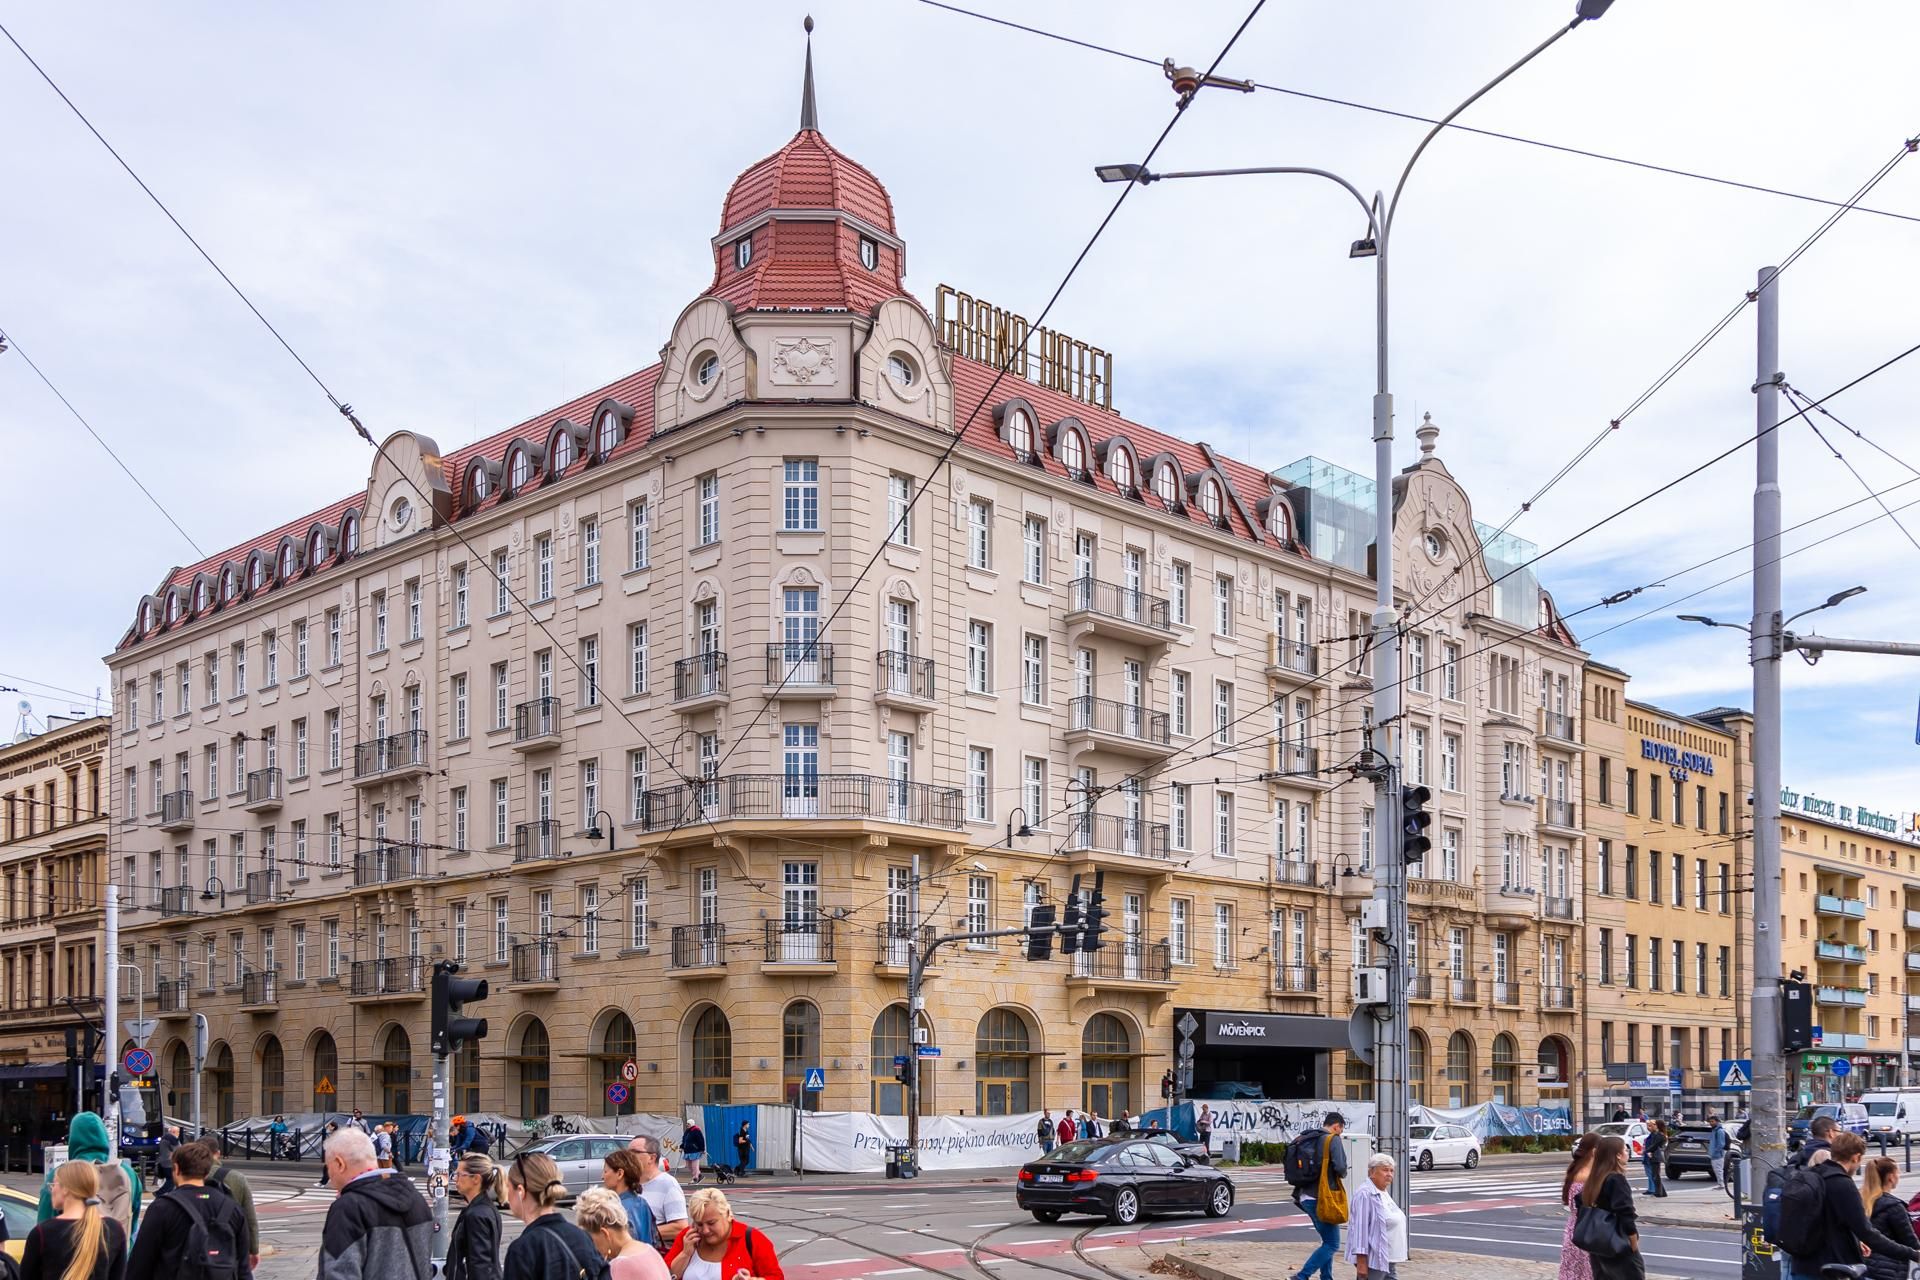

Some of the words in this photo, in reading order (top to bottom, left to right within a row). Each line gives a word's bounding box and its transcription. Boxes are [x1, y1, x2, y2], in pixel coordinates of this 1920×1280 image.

[936, 283, 1028, 380] GRAND
[1040, 326, 1120, 416] HOTEL
[1641, 739, 1681, 767] HOTEL
[1681, 751, 1714, 776] SOFIA
[1780, 786, 1799, 807] obry
[1840, 805, 1853, 821] we
[947, 1131, 985, 1155] piękno
[986, 1129, 1039, 1150] dawnego
